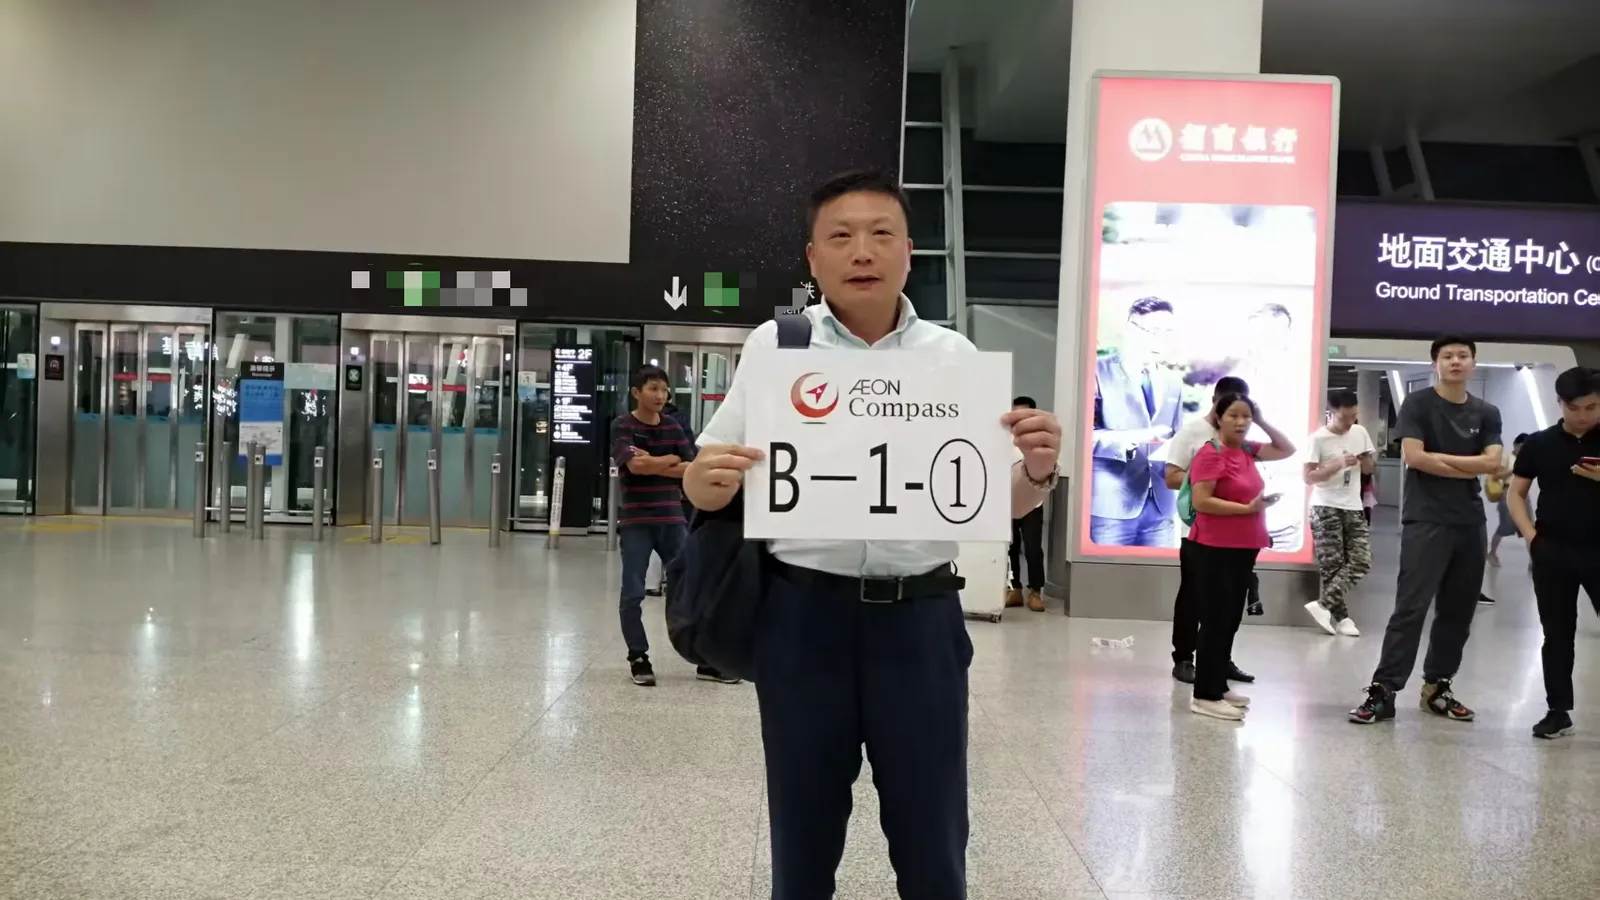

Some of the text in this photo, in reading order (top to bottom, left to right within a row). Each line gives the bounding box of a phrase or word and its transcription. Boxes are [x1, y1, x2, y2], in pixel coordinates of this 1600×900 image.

[1377, 233, 1580, 275] 地面交通中心
[1375, 281, 1600, 306] Ground Transportation Ce
[577, 349, 592, 360] 2F
[848, 397, 959, 422] Compass
